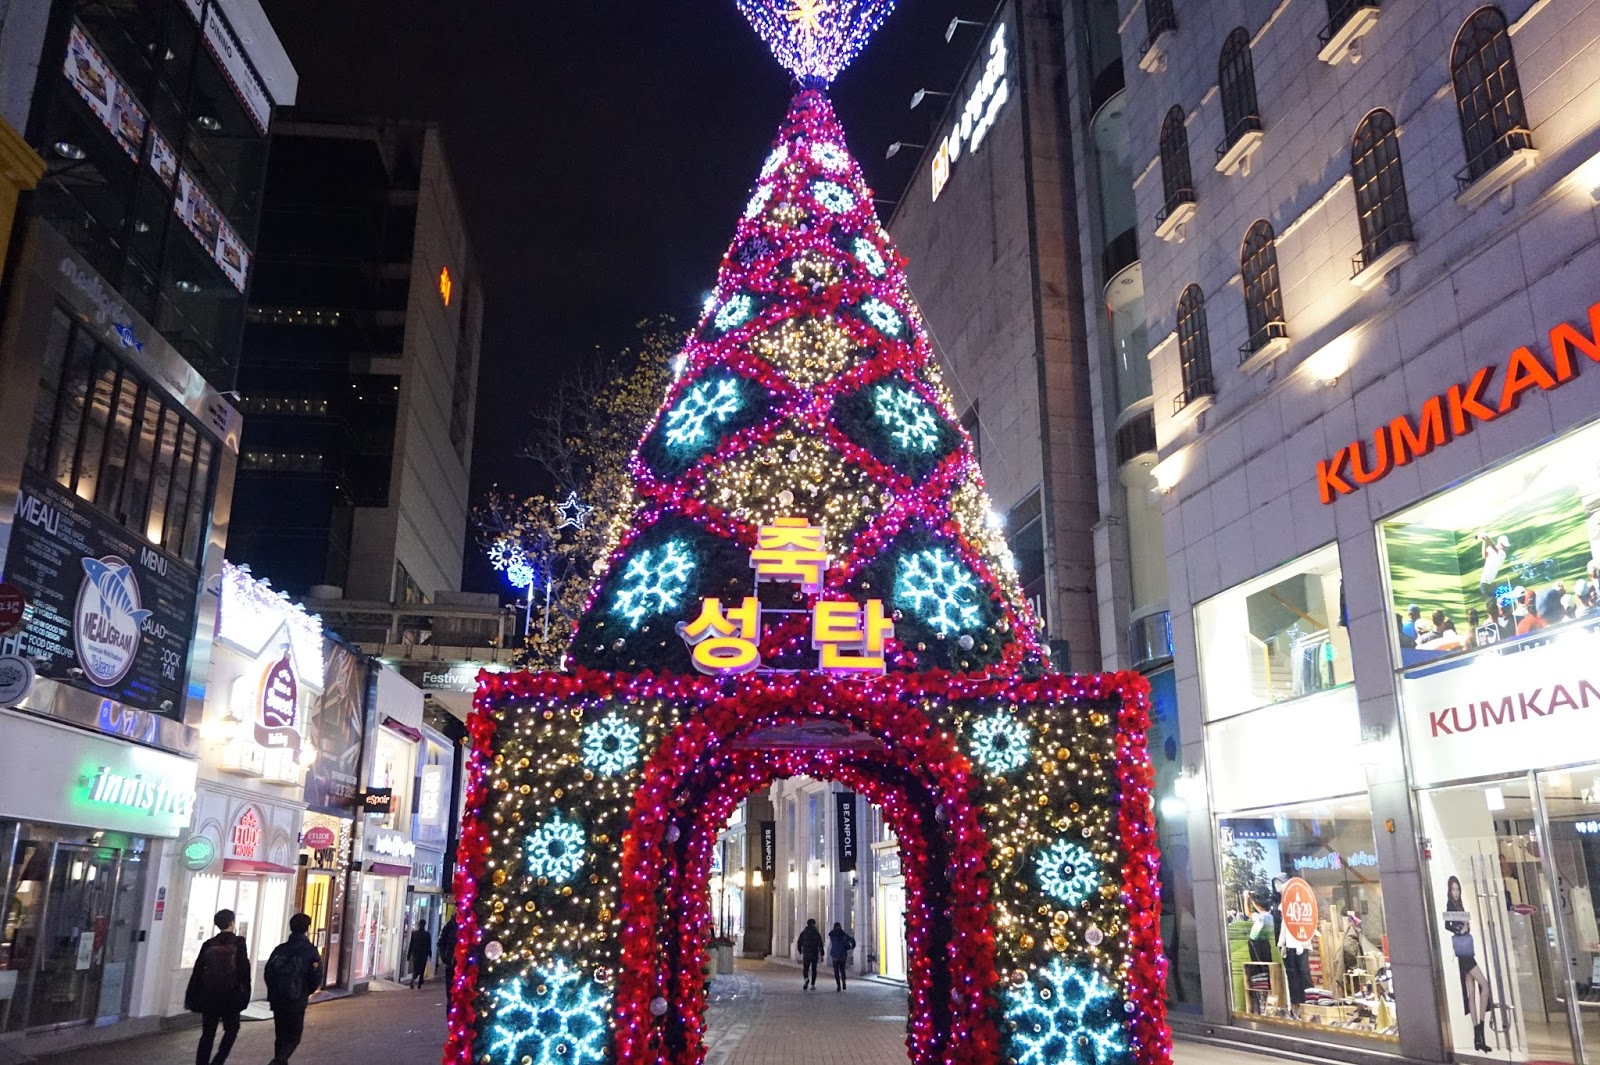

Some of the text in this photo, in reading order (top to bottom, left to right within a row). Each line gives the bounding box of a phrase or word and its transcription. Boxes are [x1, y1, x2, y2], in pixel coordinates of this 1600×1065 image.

[210, 17, 232, 58] DINING
[1316, 301, 1600, 505] KUMKAN
[140, 546, 168, 577] MENU
[750, 517, 828, 590] 축
[28, 633, 46, 648] FOOD
[45, 640, 74, 659] DEVELOPER
[141, 617, 166, 640] SALAD
[683, 597, 894, 672] 성탄
[423, 671, 469, 684] Festival
[91, 766, 196, 816] innisfree
[234, 825, 262, 846] ETUDE
[308, 832, 330, 840] ETUDE
[843, 802, 852, 857] BEANPOLE
